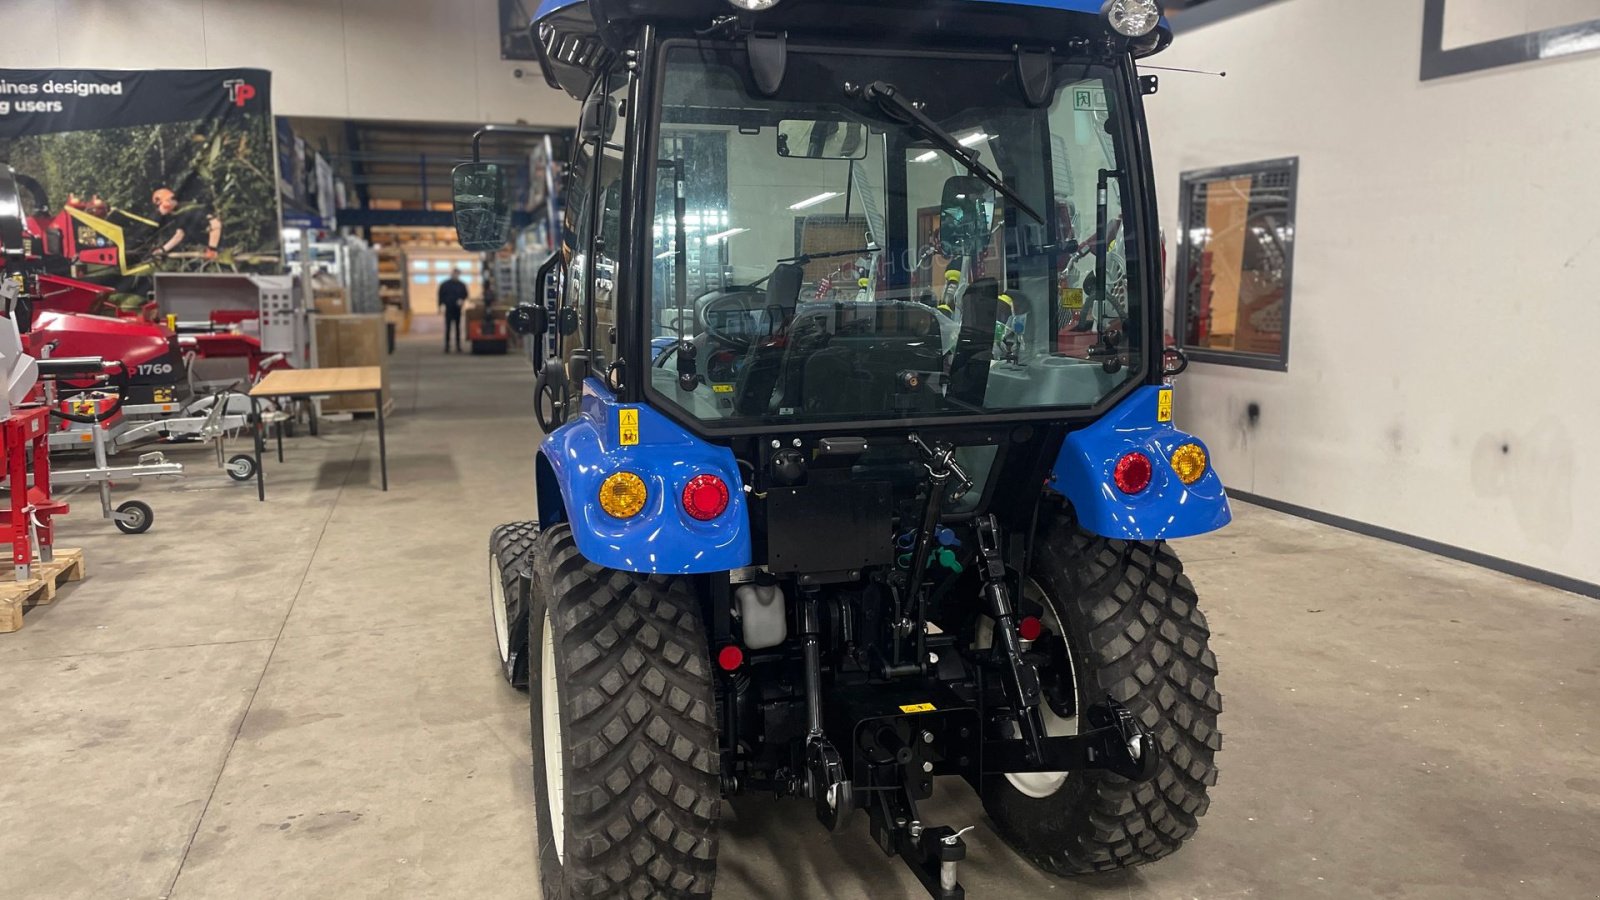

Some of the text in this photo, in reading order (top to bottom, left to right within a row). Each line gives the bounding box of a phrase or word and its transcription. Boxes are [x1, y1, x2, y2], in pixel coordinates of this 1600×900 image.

[0, 79, 122, 96] ines designed
[223, 79, 256, 107] TP
[15, 101, 63, 112] users
